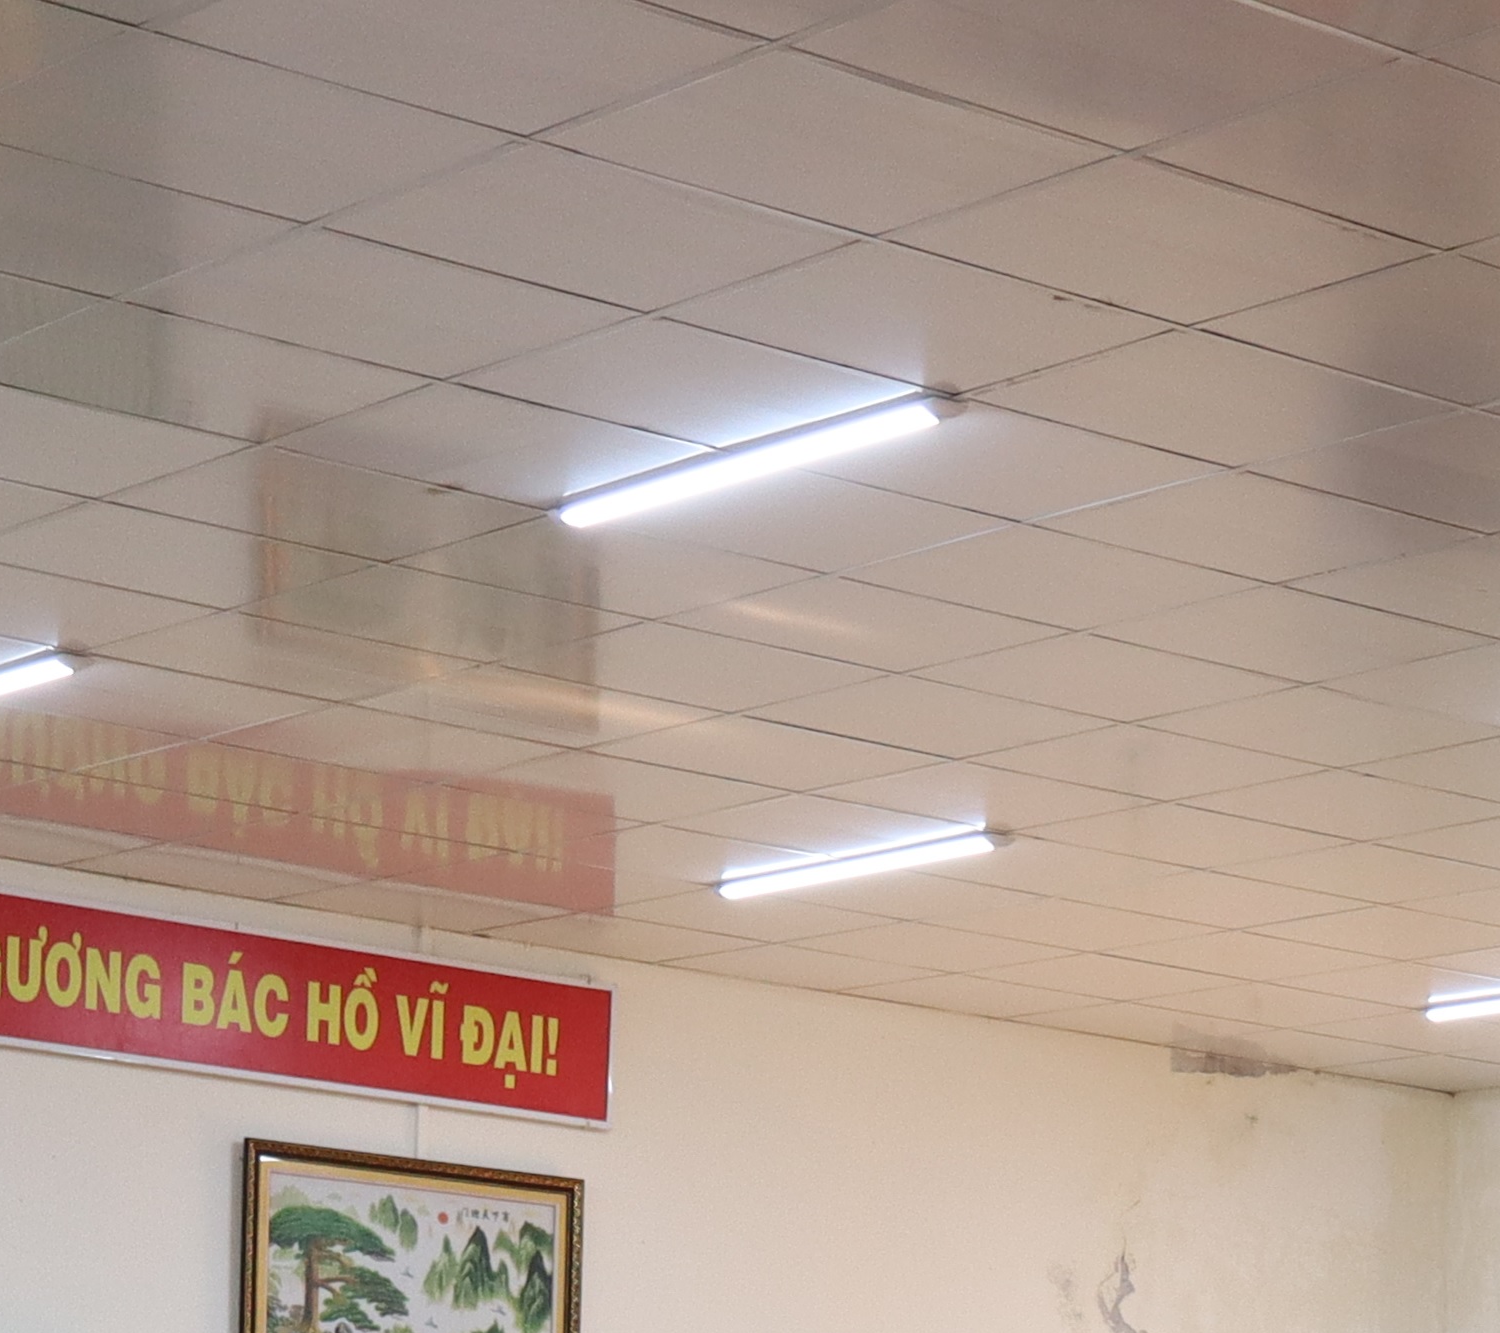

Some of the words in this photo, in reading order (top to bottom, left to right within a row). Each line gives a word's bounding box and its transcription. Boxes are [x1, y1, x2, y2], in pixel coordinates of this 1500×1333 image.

[184, 952, 288, 1036] BÁC
[308, 968, 378, 1049] HỒ
[398, 983, 447, 1058] VĨ
[461, 1006, 558, 1087] ĐẠI!
